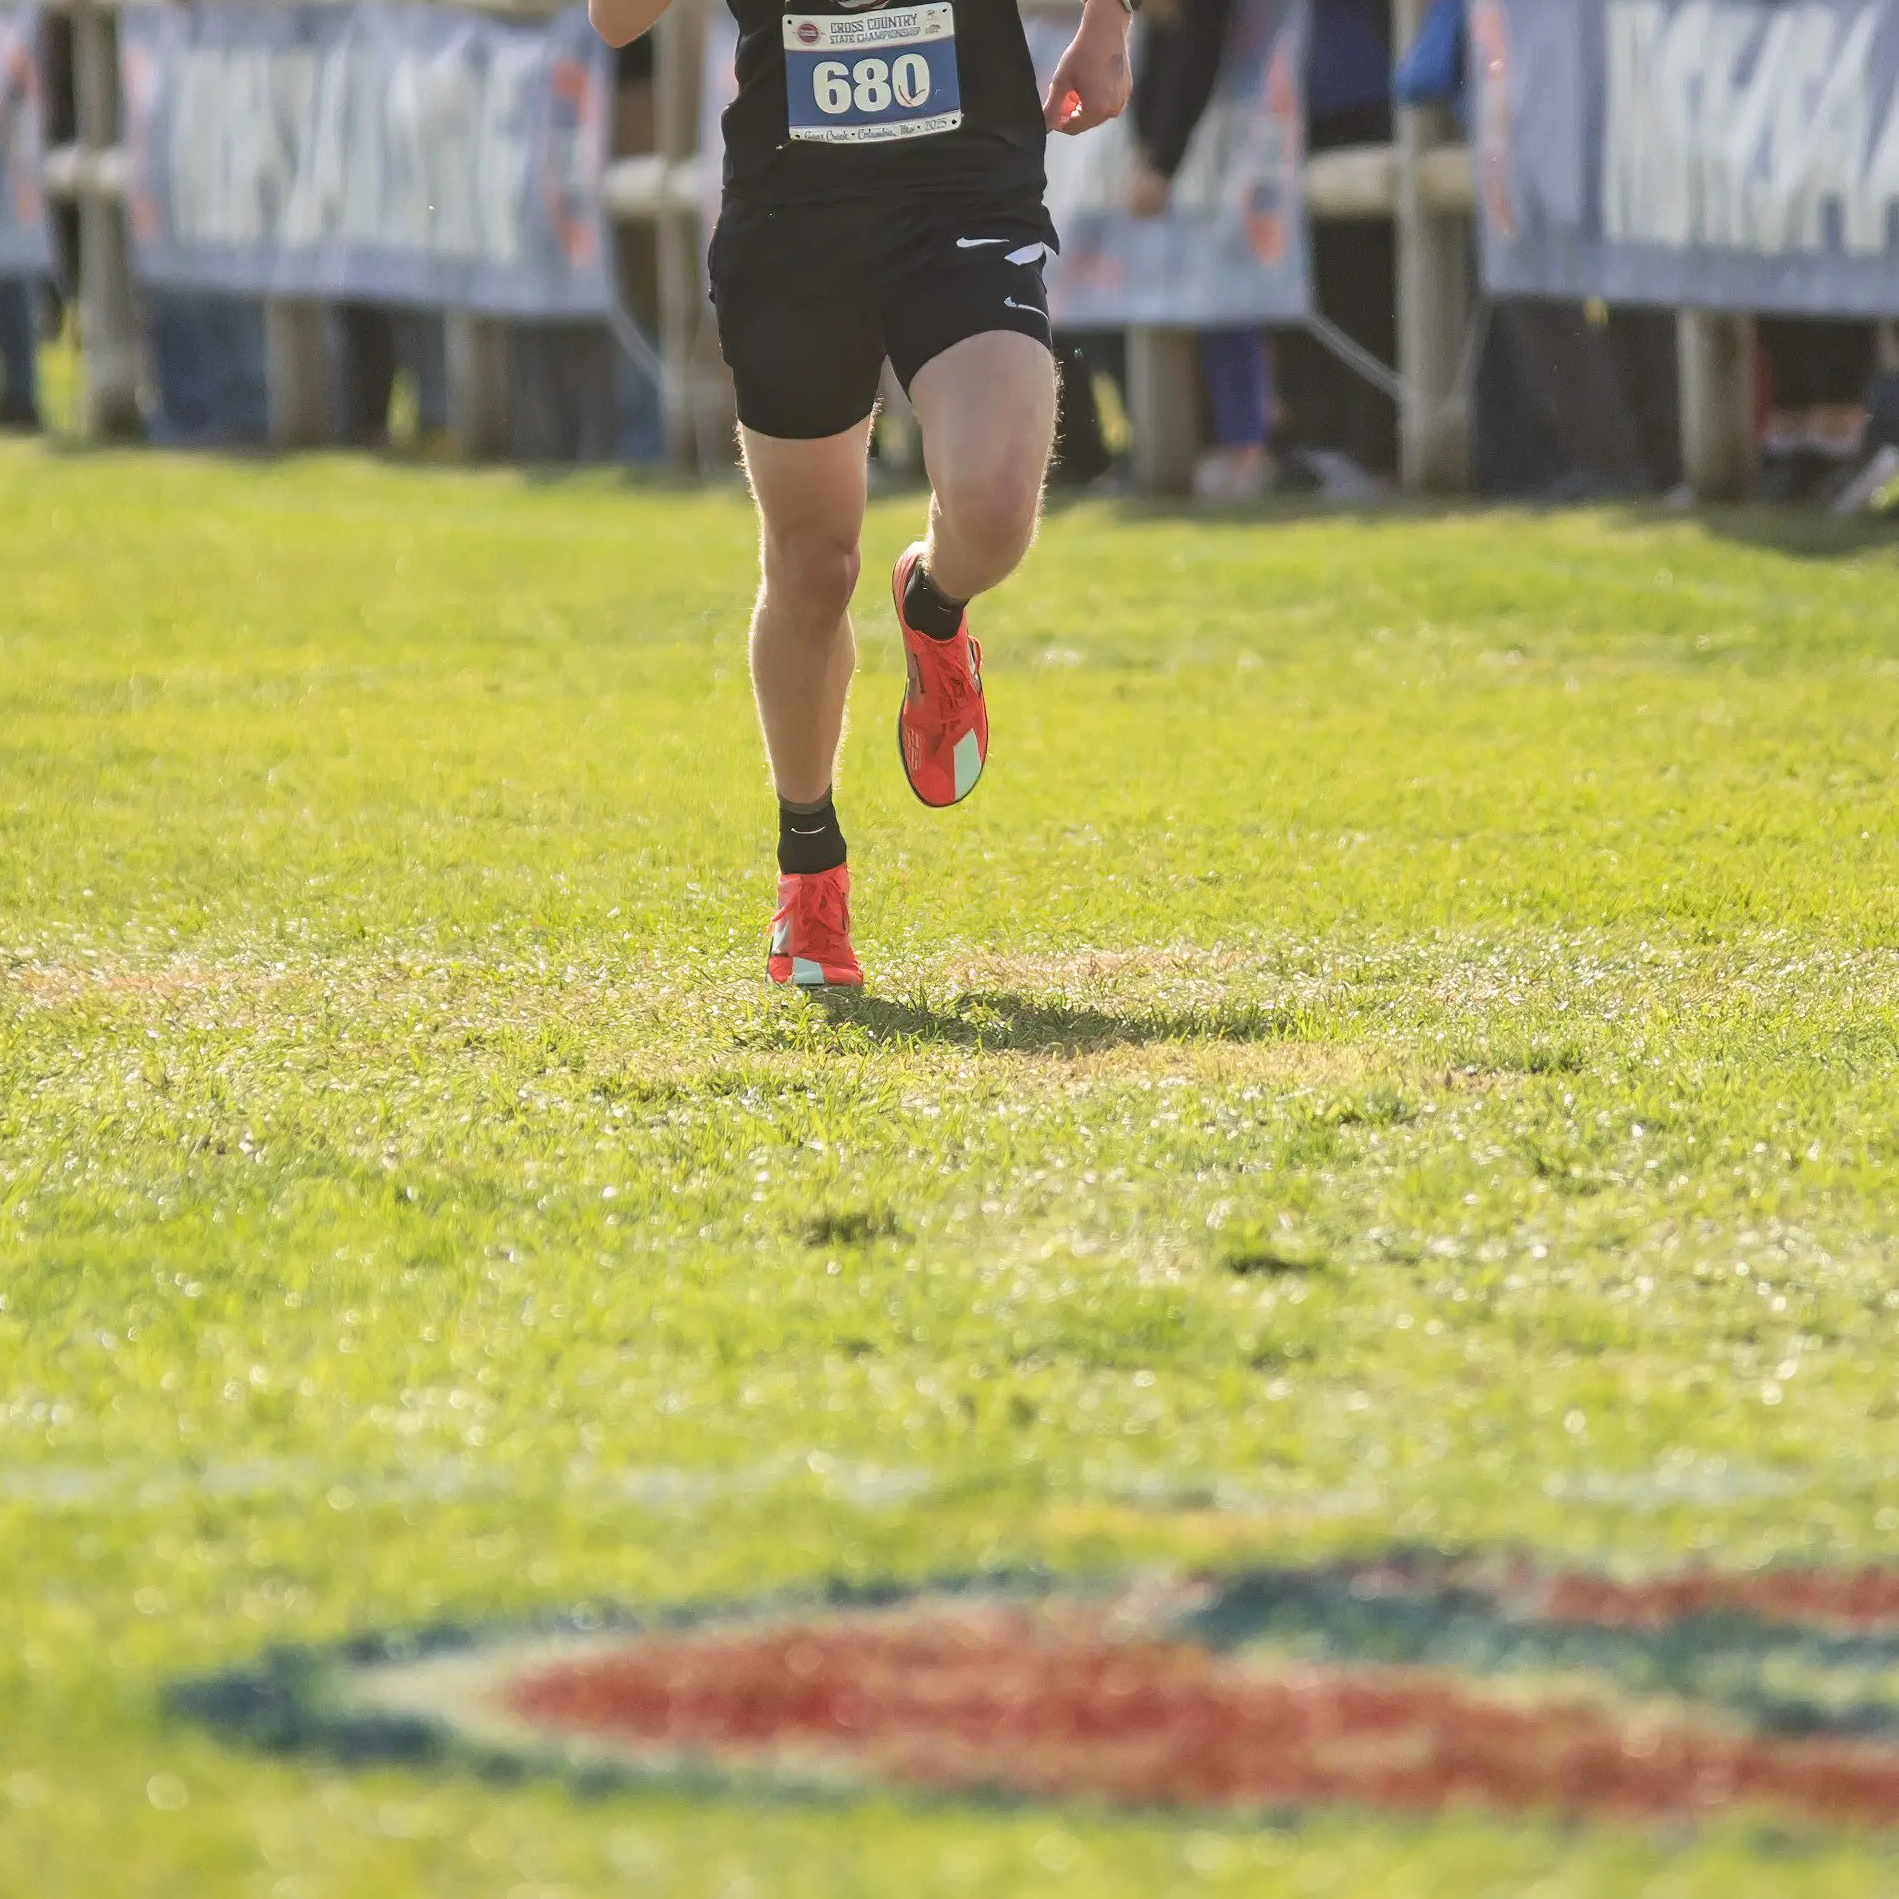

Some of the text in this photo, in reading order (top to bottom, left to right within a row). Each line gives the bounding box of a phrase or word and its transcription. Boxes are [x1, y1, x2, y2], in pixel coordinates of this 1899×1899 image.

[830, 20, 864, 34] CROSS
[867, 13, 917, 31] COUNTRY
[829, 34, 855, 45] STATE
[856, 26, 921, 42] CHAMPIONSHIP
[813, 53, 930, 114] 680
